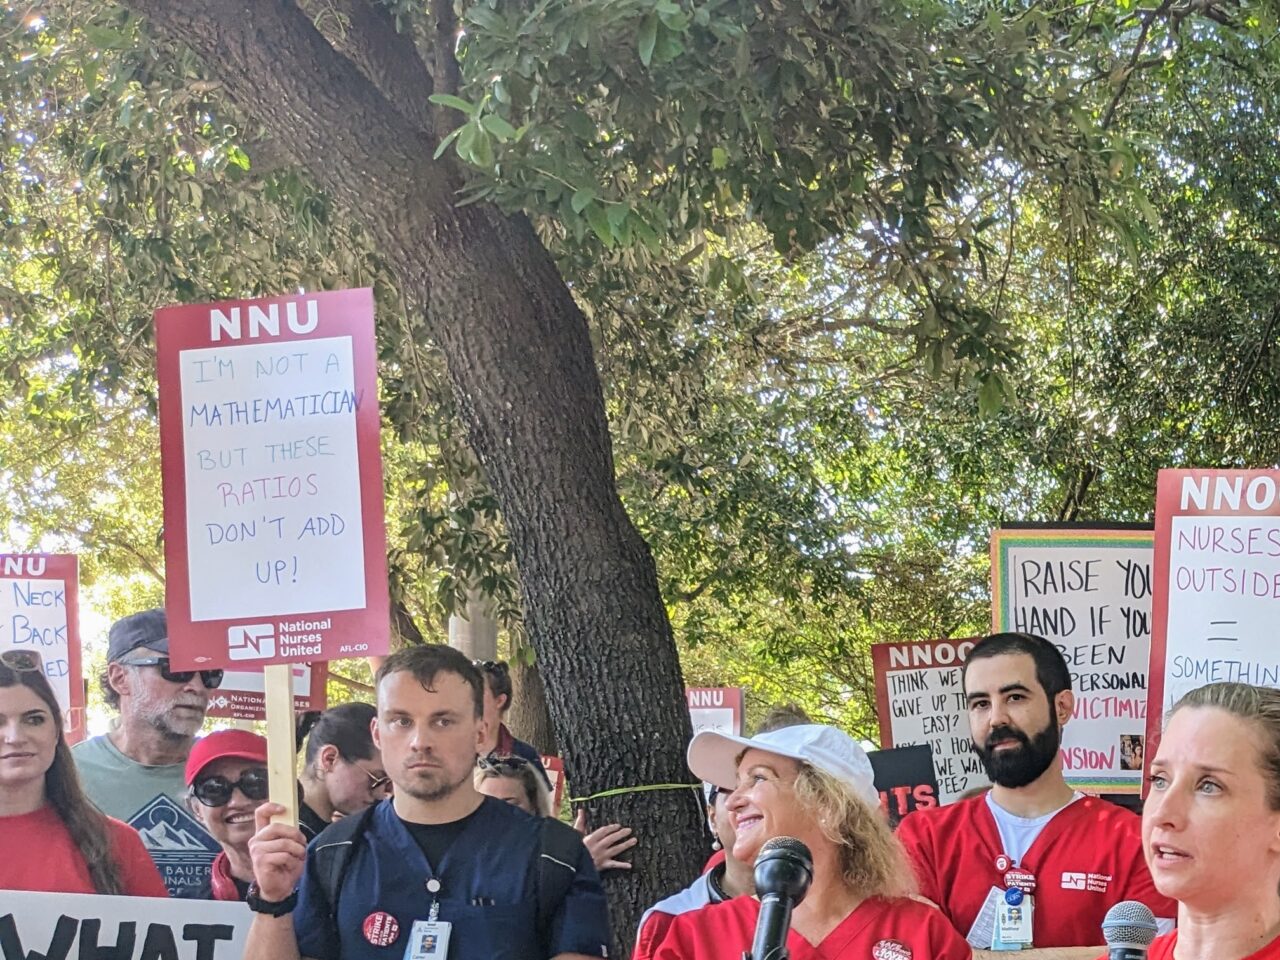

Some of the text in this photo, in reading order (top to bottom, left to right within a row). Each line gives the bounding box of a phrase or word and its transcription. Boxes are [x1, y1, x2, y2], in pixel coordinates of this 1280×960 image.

[209, 300, 319, 341] NNU
[192, 351, 340, 384] I'M NOT A
[190, 388, 364, 428] MATHEMATICIAN
[197, 434, 336, 472] BUT THESE
[216, 472, 320, 508] RATIOS
[205, 512, 346, 546] DON'T ADD
[255, 555, 299, 587] UP!
[1021, 559, 1102, 598] RAISE
[13, 581, 66, 607] NECK
[12, 614, 67, 646] BACK
[279, 618, 331, 634] National
[1014, 606, 1076, 637] HAND
[1090, 604, 1111, 638] IF
[279, 632, 322, 646] Nurses
[279, 643, 322, 657] United
[339, 642, 369, 654] AFL-CIO
[887, 671, 929, 696] THINK
[689, 690, 724, 707] NNU
[892, 697, 923, 718] GIVE
[931, 694, 947, 712] UP
[923, 714, 960, 735] EASY?
[935, 757, 955, 777] WE
